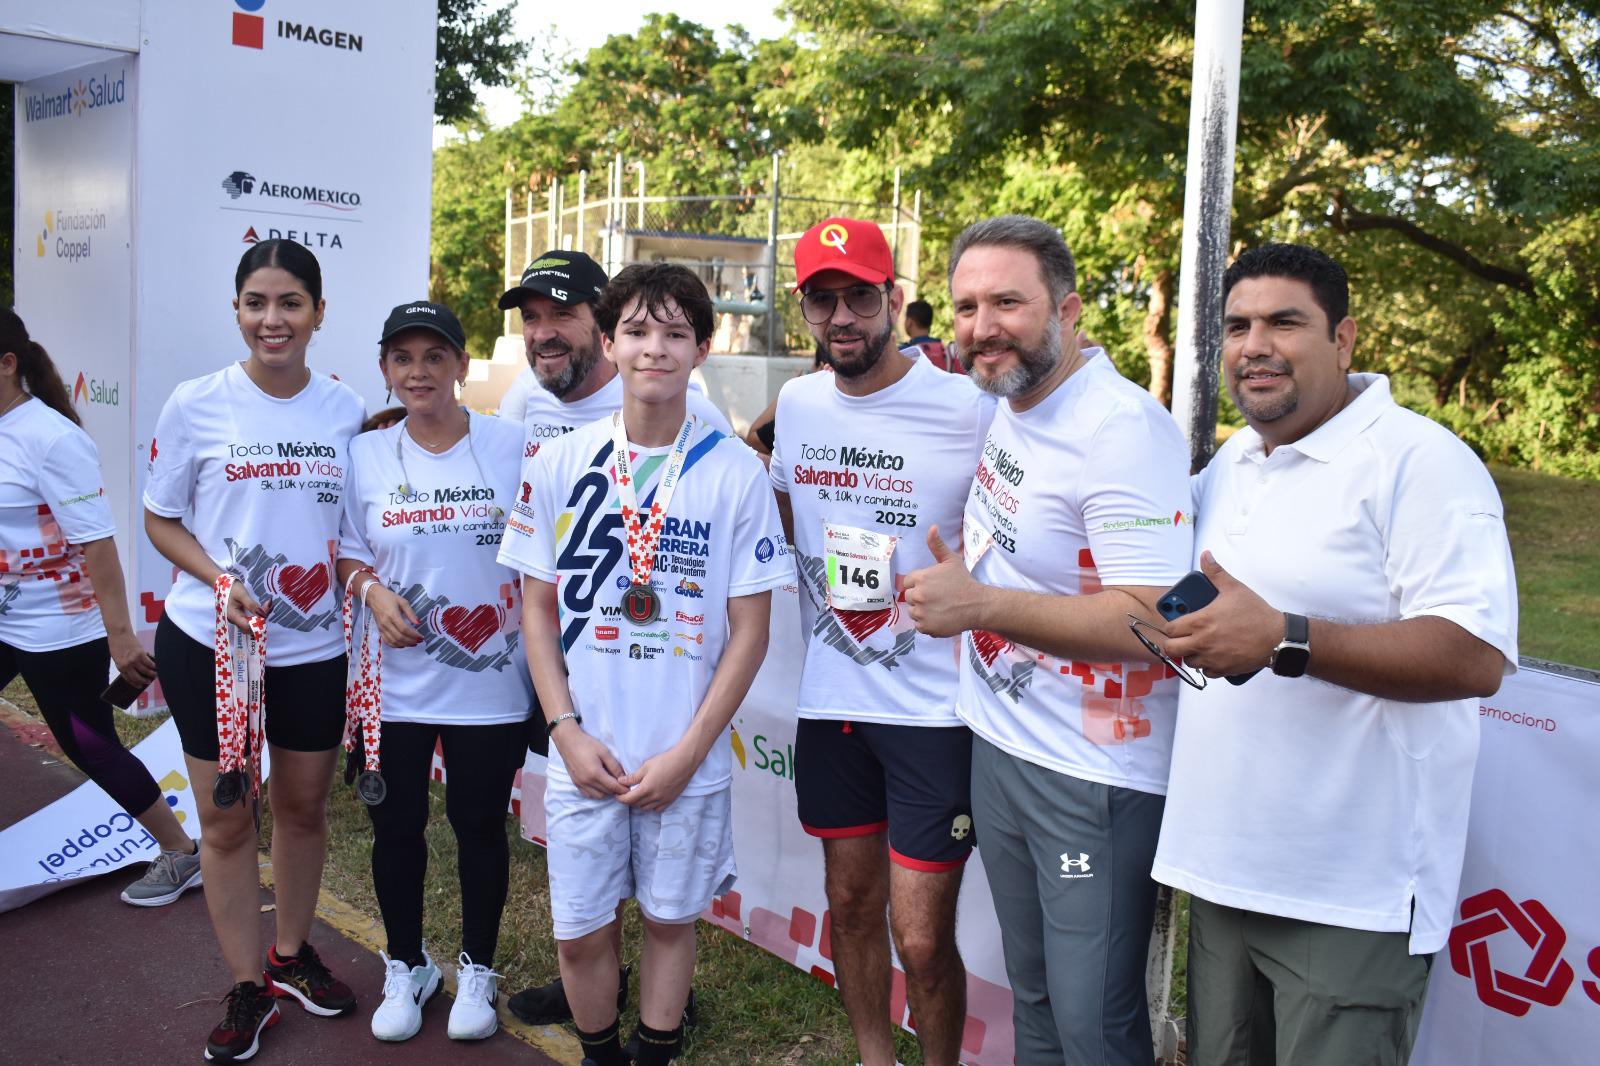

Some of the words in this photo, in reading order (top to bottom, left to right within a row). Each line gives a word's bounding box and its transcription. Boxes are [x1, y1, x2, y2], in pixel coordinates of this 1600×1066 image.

[277, 20, 363, 52] IMAGEN
[24, 88, 72, 123] Walmart
[88, 70, 125, 110] Salud
[56, 210, 106, 231] Fundación
[56, 237, 92, 264] Coppel
[269, 229, 343, 249] DELTA
[820, 224, 846, 254] Q
[554, 271, 570, 279] TEAM
[406, 306, 436, 315] GEMINI
[90, 380, 119, 406] Salud
[532, 424, 560, 438] Todo
[676, 421, 692, 454] Walmart
[228, 443, 274, 458] Todo
[277, 441, 336, 458] México
[801, 444, 836, 460] Todo
[840, 446, 904, 471] México
[224, 459, 300, 482] Salvando
[305, 460, 343, 478] Vidas
[664, 464, 679, 488] Salud
[794, 464, 858, 488] Salvando
[863, 473, 913, 494] Vidas
[993, 448, 1024, 486] México
[261, 480, 276, 492] 5k,
[279, 480, 296, 490] 10k
[300, 482, 306, 490] y
[389, 491, 430, 505] Todo
[434, 486, 494, 503] México
[818, 489, 832, 502] 5k,
[835, 490, 852, 502] 10k
[856, 494, 862, 504] y
[994, 482, 1020, 514] Vidas
[382, 504, 455, 528] Salvando
[660, 516, 711, 540] RAN
[875, 510, 917, 528] 2023
[412, 526, 428, 536] 5k,
[432, 524, 450, 534] 10k
[454, 525, 460, 534] y
[476, 534, 504, 546] 202
[992, 524, 1016, 554] 2023
[656, 538, 709, 557] RRERA
[671, 564, 679, 573] de
[680, 566, 706, 578] Monterrey
[672, 554, 705, 568] Tecnológico
[840, 565, 879, 590] 146
[753, 734, 795, 782] Sal
[38, 812, 134, 874] Coppel
